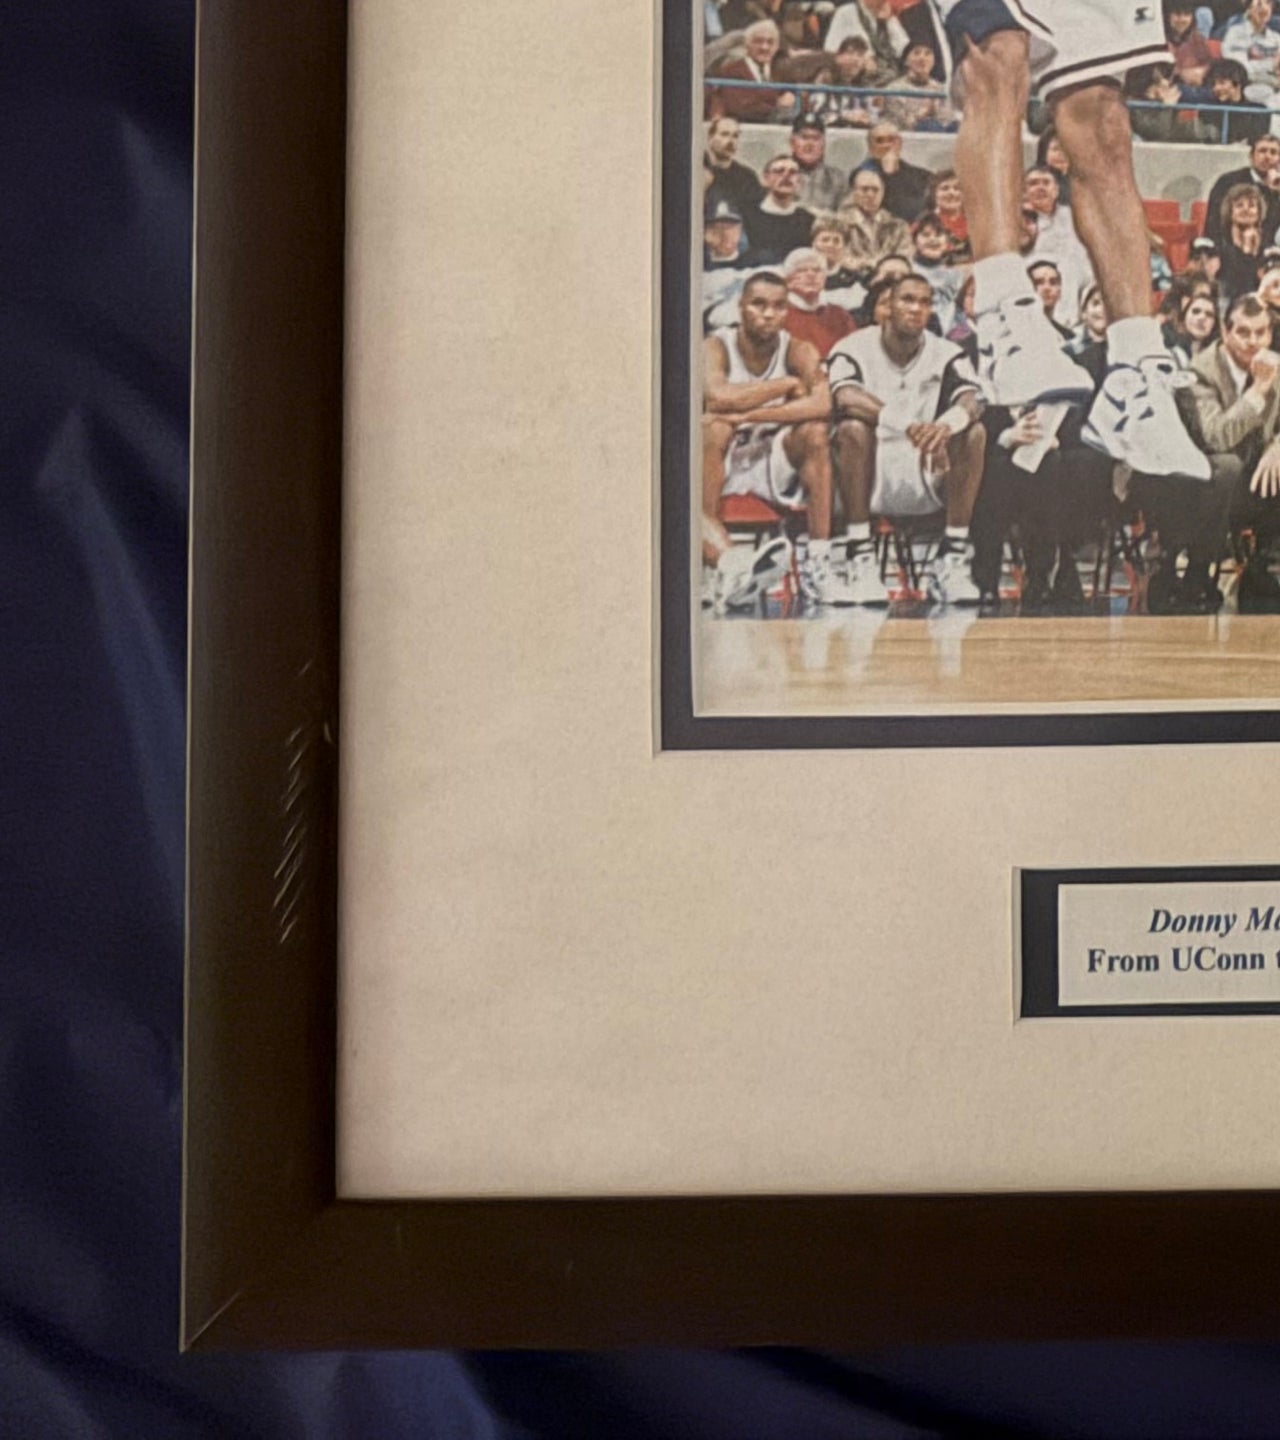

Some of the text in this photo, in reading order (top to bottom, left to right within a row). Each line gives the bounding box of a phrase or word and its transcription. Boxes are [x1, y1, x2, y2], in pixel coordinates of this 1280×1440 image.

[1147, 907, 1237, 938] Donny
[1086, 947, 1160, 974] From
[1172, 945, 1266, 972] UConn
